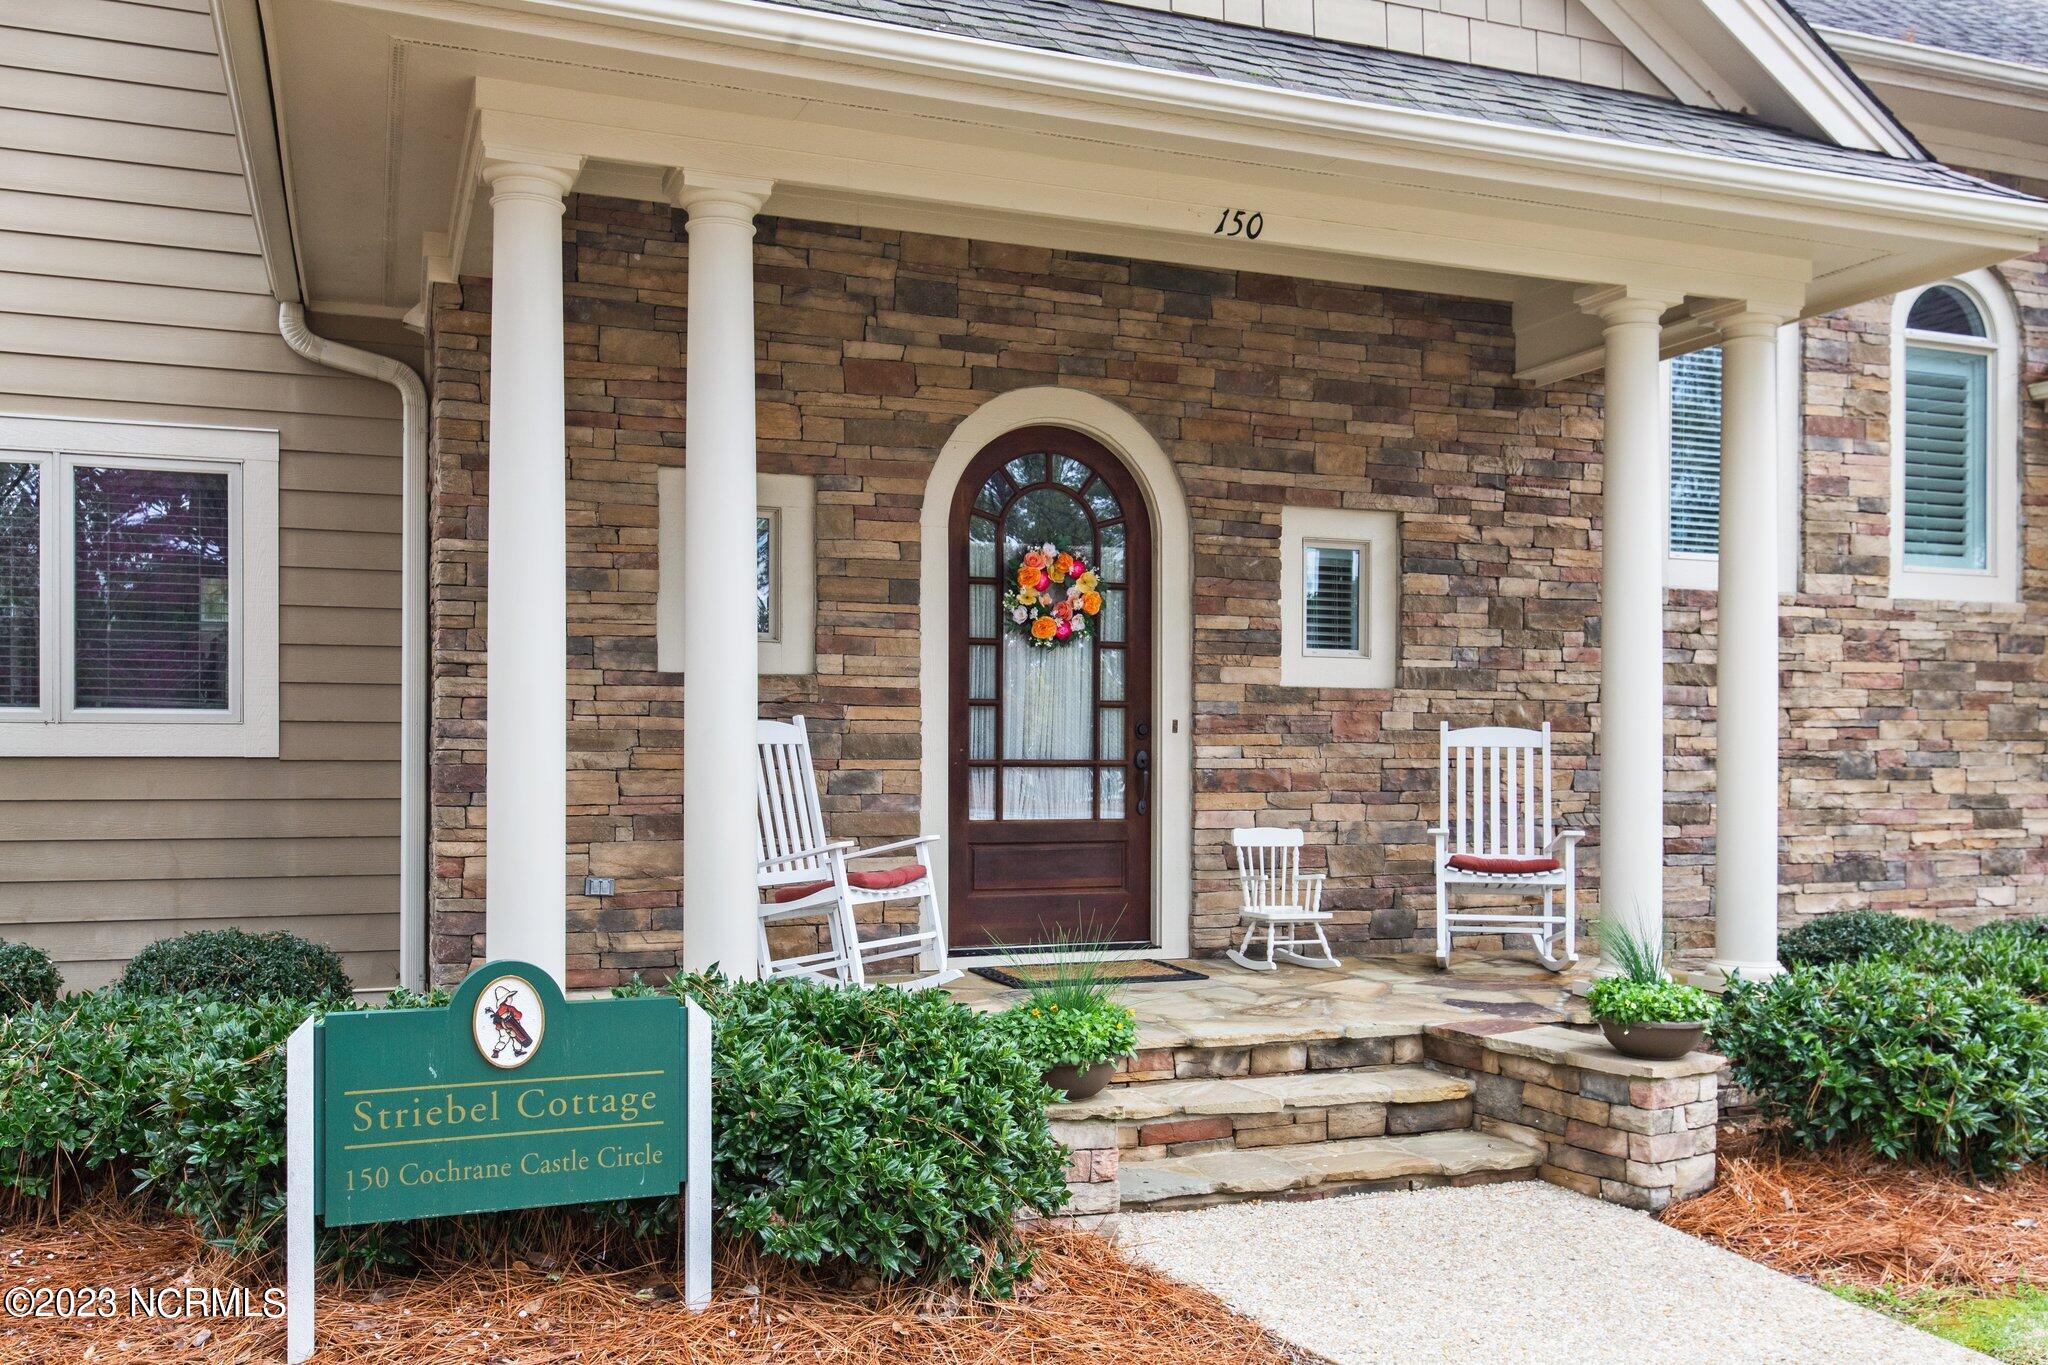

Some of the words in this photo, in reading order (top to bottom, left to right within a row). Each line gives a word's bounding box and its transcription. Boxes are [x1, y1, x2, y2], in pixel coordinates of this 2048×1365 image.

[1214, 208, 1263, 240] 150
[352, 1089, 500, 1133] Striebel
[517, 1088, 657, 1121] Cottage
[345, 1165, 389, 1192] 150
[399, 1158, 512, 1187] Cochrane
[520, 1149, 589, 1176] Castle
[597, 1143, 664, 1169] Circle
